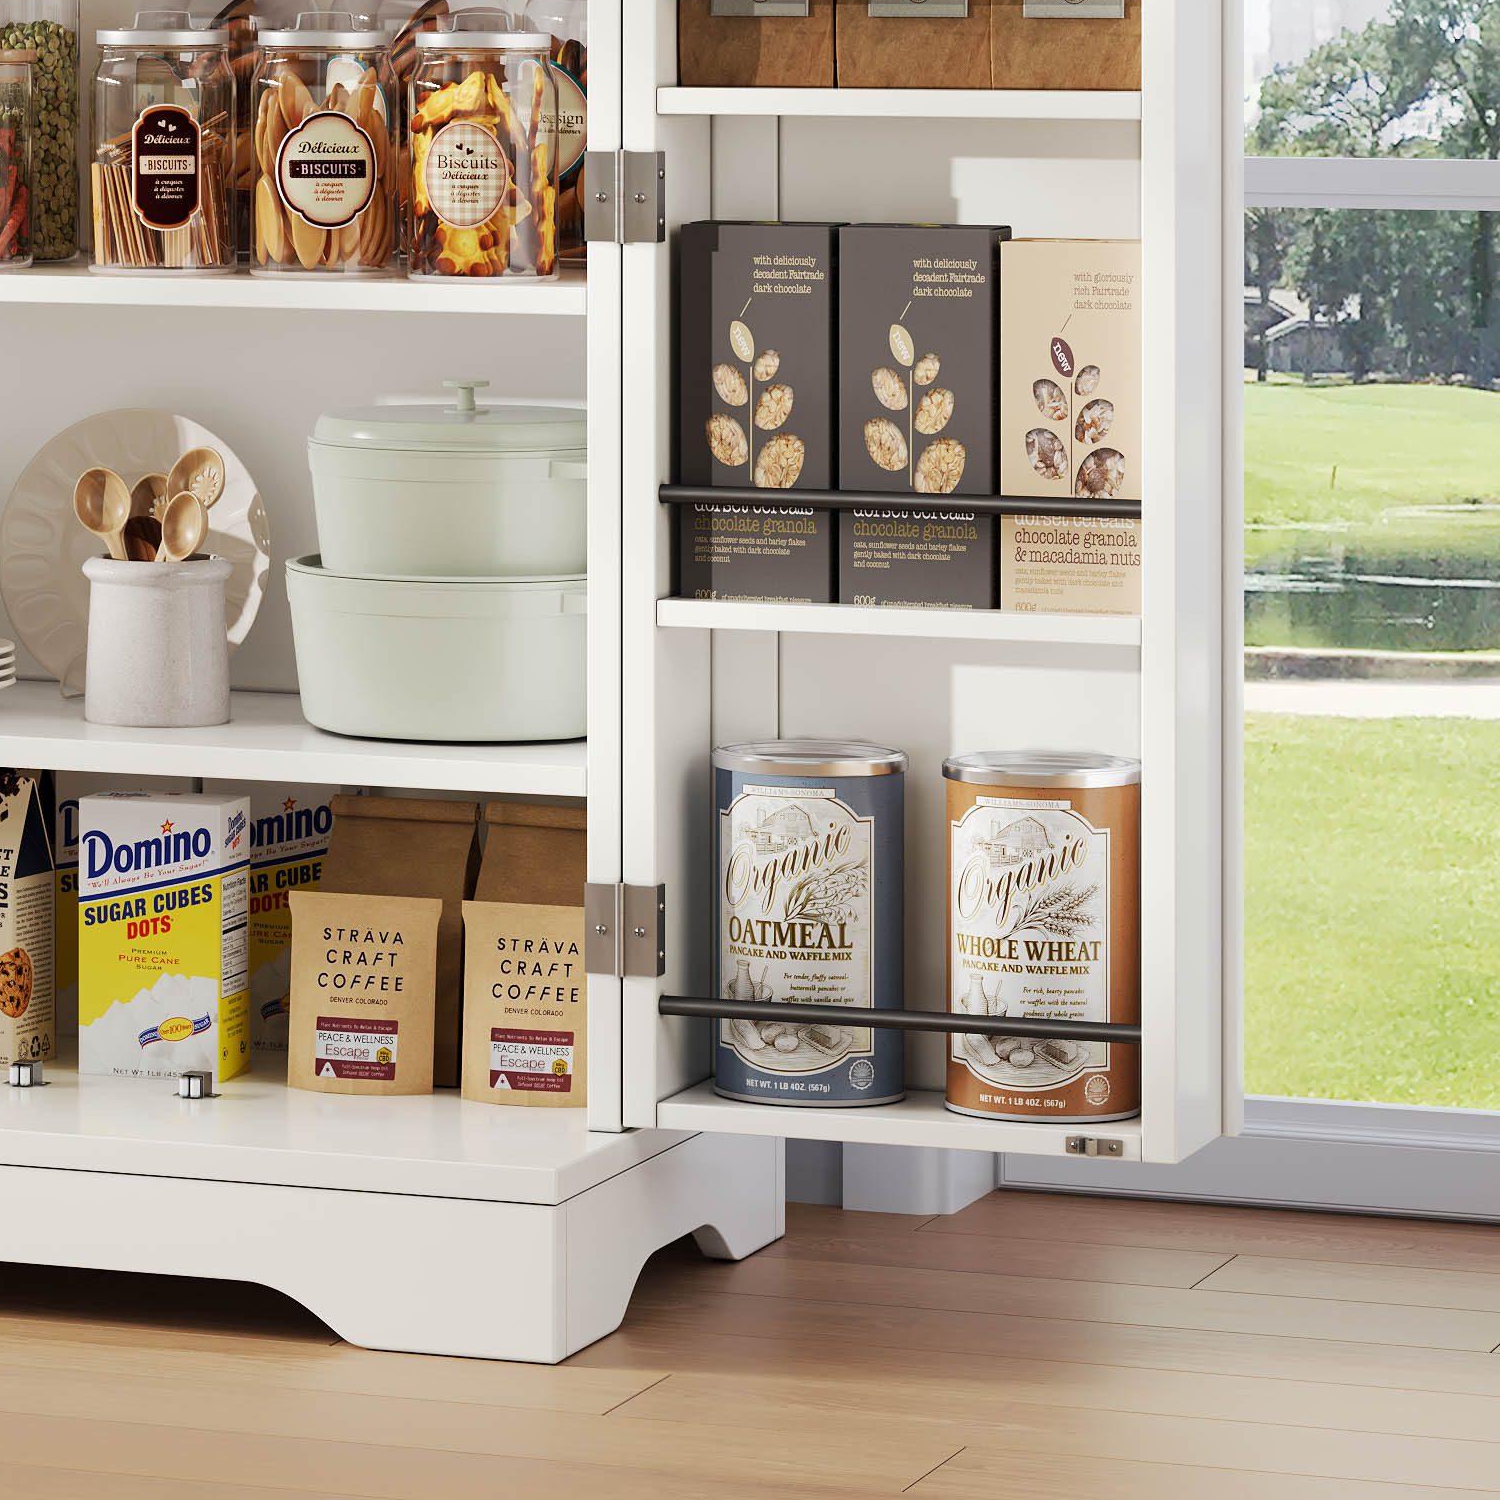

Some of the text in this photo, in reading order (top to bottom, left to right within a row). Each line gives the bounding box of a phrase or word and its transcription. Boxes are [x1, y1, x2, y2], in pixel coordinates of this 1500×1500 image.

[144, 133, 191, 144] Délicieux
[298, 141, 360, 154] Délicieux
[148, 159, 188, 171] BISCUITS
[301, 163, 357, 175] BISCUITS
[437, 154, 498, 170] Biscuits
[442, 171, 489, 181] Délicieux
[753, 255, 817, 268] with deliciously
[753, 269, 825, 280] decadent Fairtrade
[1073, 272, 1134, 285] with gloriously
[753, 283, 812, 294] dark chocolate
[1074, 286, 1130, 297] rich Fairtrade
[1073, 300, 1132, 310] dark chocolate
[1052, 341, 1072, 373] new
[695, 515, 817, 536] chocolate granola
[853, 520, 978, 541] chocolate granola
[1014, 529, 1138, 549] chocolate granola
[1014, 546, 1141, 566] & macadamia nuts
[82, 827, 212, 880] Domino
[725, 821, 851, 916] Organic
[958, 834, 1086, 928] Organic
[84, 883, 213, 926] SUGAR CUBES
[127, 915, 171, 940] DOTS
[323, 927, 404, 945] STRÄVA
[729, 915, 853, 950] OATMEAL
[497, 937, 579, 955] STRÄVA
[729, 945, 853, 961] PANCAKE AND WAFFLE MIX
[956, 933, 1102, 962] WHOLE WHEAT
[326, 949, 398, 967] CRAFT
[500, 959, 573, 978] CRAFT
[318, 972, 404, 992] COFFEE
[329, 996, 388, 1006] DENVER COLORADO
[492, 983, 580, 1003] COFFEE
[318, 1032, 394, 1045] PEACE & WELLNESS
[325, 1043, 370, 1059] Escape
[746, 1078, 759, 1087] NET
[759, 1080, 773, 1089] WT.
[773, 1081, 778, 1090] 1
[779, 1082, 789, 1090] LB
[808, 1083, 831, 1093] (567g)
